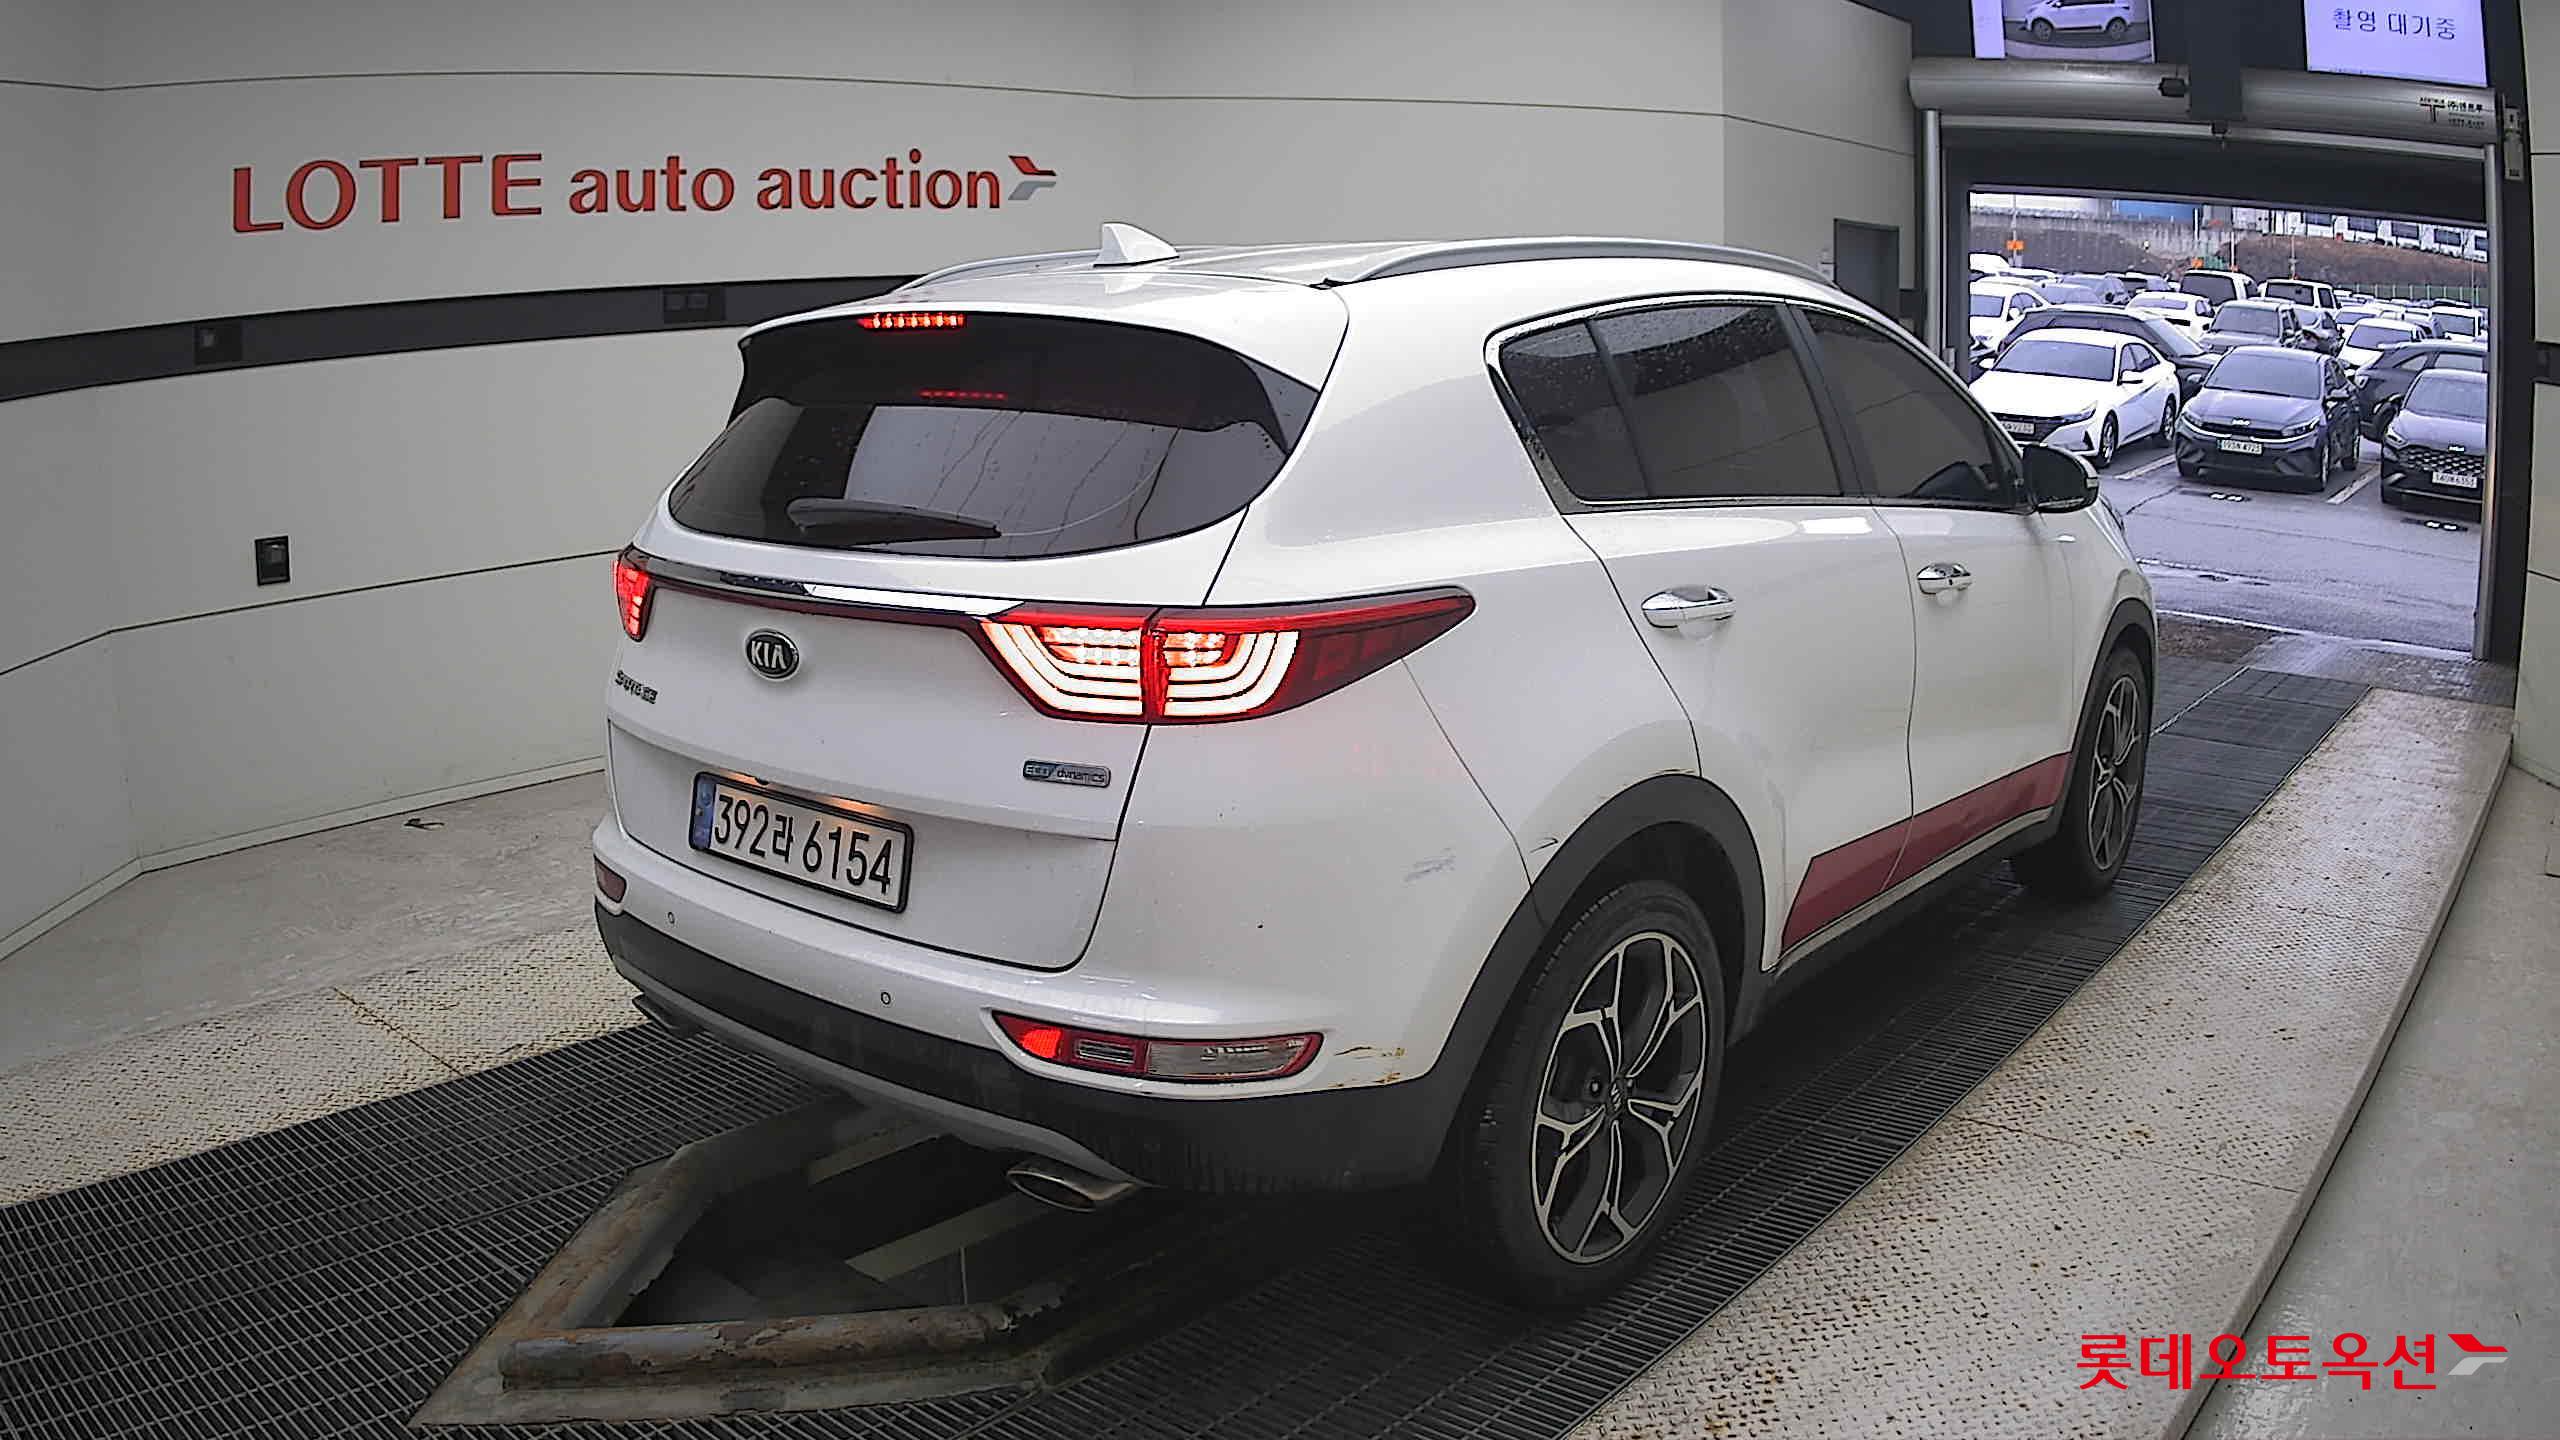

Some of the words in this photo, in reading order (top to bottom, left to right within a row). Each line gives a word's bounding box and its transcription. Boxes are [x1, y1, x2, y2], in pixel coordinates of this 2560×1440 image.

[2388, 13, 2455, 40] 대기중
[232, 152, 543, 233] LOTTE
[568, 156, 735, 214] auto
[757, 148, 1001, 210] auction
[751, 640, 787, 669] KIA
[714, 794, 794, 863] 392라
[802, 820, 891, 894] 6154
